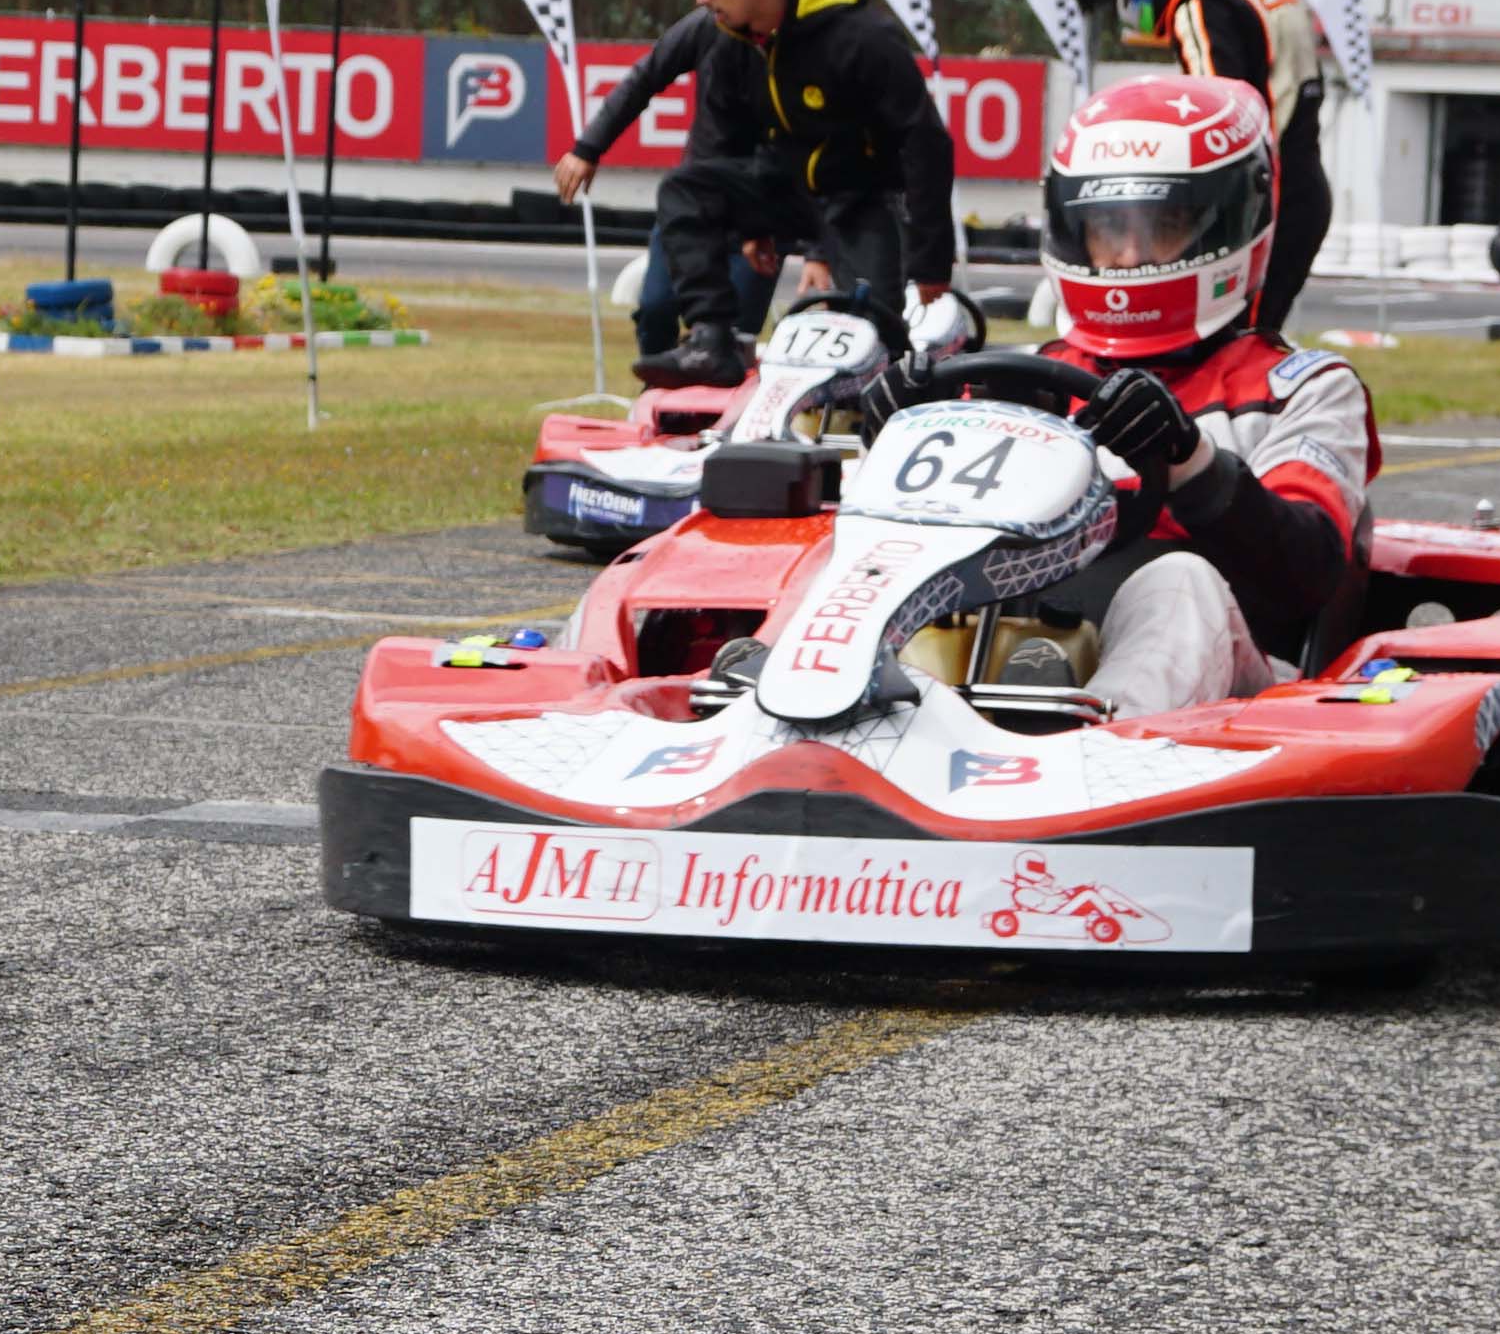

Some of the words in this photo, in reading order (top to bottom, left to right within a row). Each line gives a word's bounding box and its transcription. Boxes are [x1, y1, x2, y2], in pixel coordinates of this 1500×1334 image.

[1077, 180, 1173, 199] Karters
[1084, 309, 1162, 324] vodafone
[784, 327, 856, 359] 175
[904, 417, 1065, 445] EUROINDY
[894, 431, 1017, 500] 64
[464, 833, 600, 905] AJM
[675, 849, 965, 927] Informática
